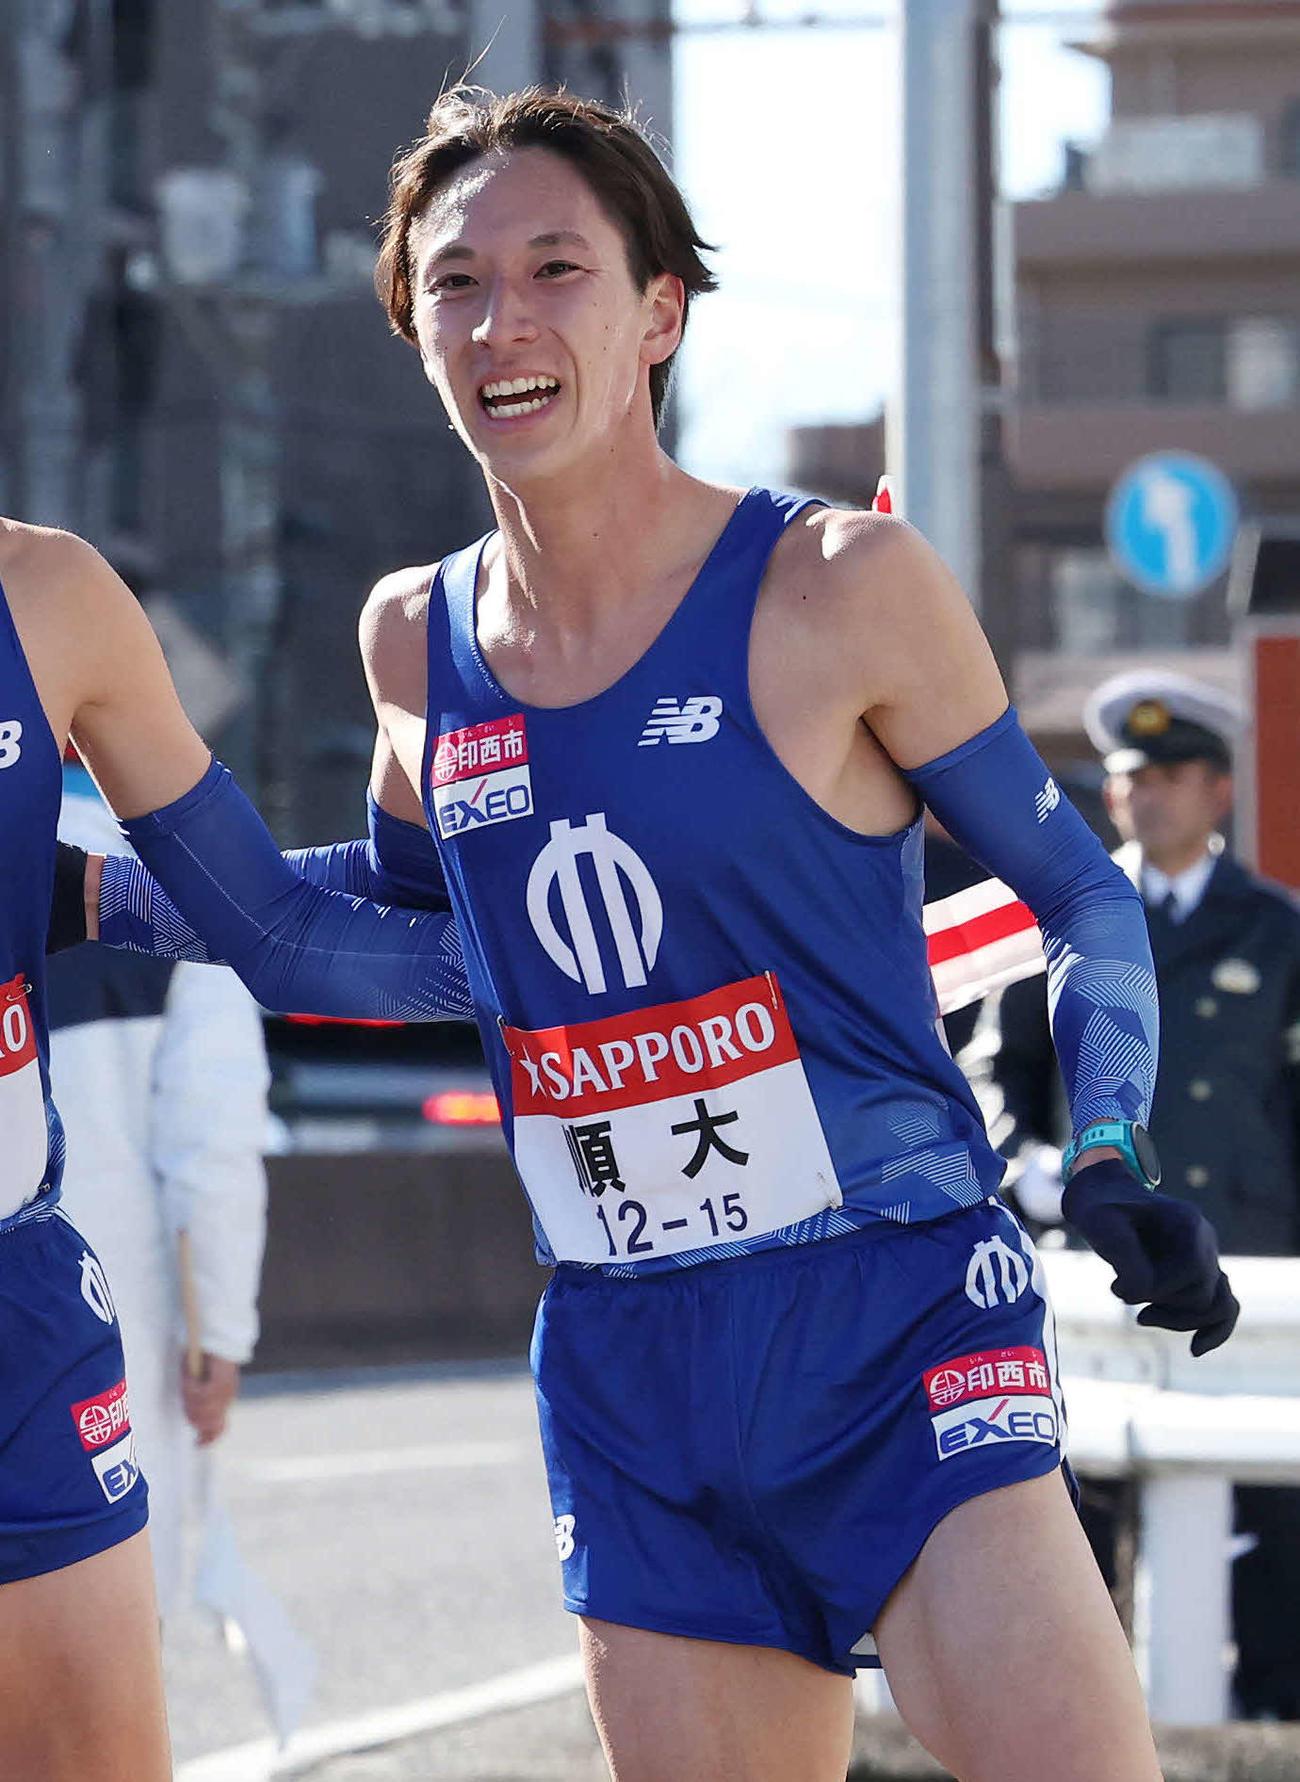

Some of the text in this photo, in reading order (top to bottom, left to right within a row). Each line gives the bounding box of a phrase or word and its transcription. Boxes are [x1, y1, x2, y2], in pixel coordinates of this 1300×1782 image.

[457, 729, 524, 771] 印西市
[440, 778, 530, 834] EXEO
[540, 1002, 776, 1101] SAPPORO
[967, 1361, 1048, 1392] 印西市
[940, 1399, 1055, 1454] EXEO
